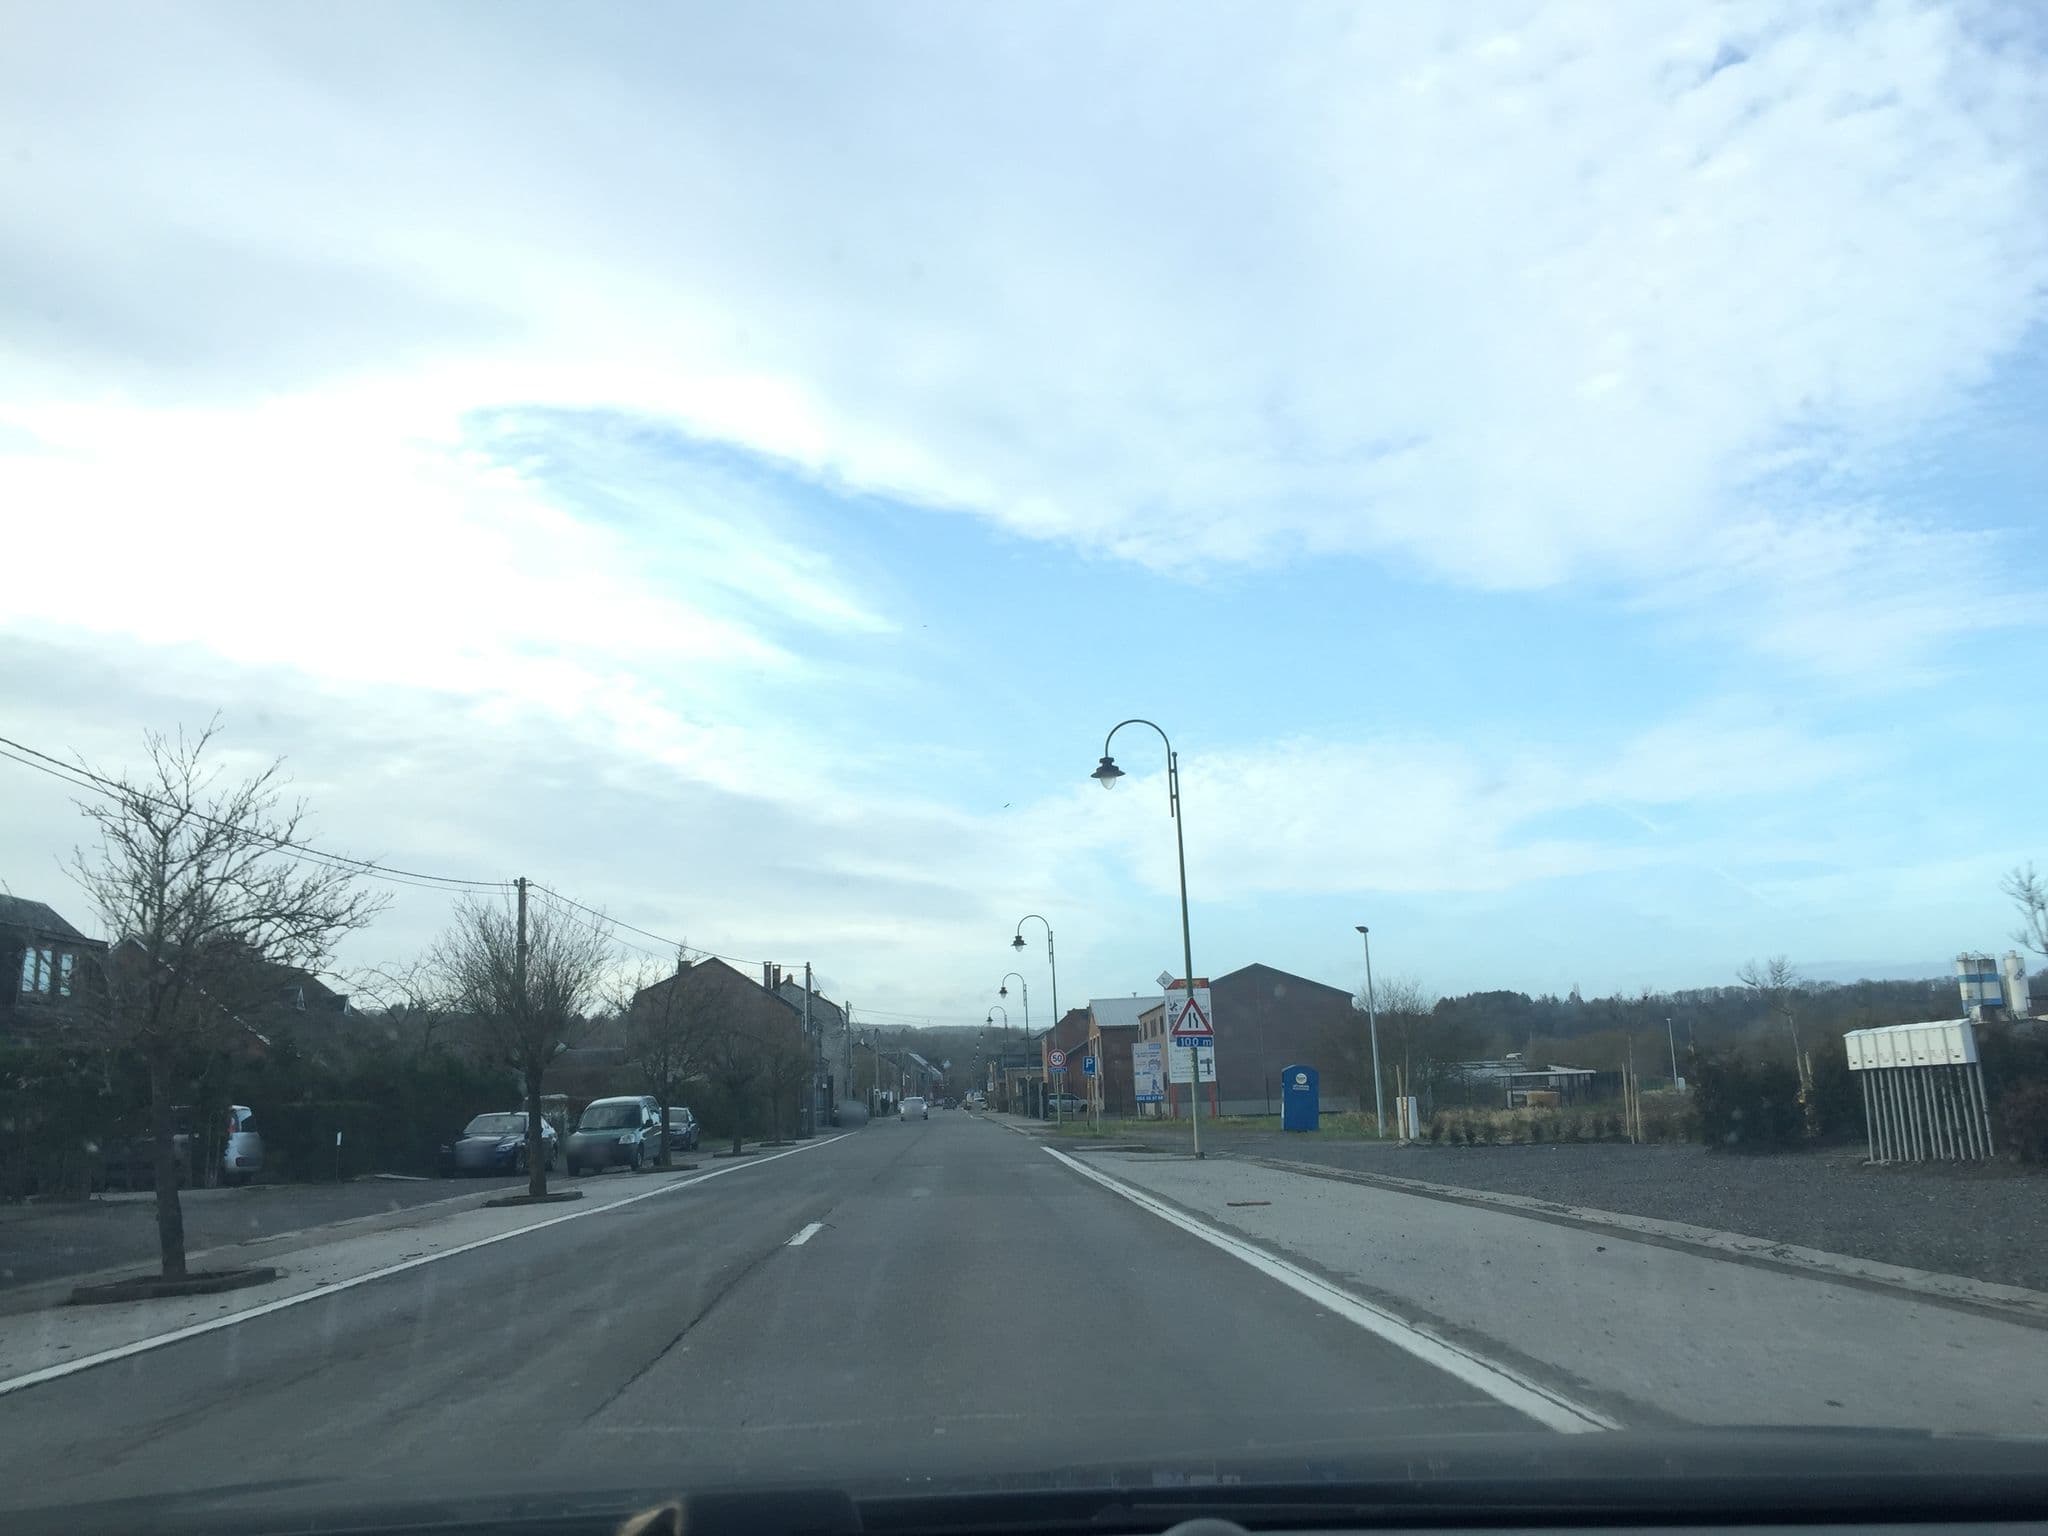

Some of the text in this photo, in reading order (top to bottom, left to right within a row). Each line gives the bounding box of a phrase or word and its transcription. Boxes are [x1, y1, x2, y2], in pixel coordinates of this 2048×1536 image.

[1181, 1037, 1199, 1046] 100
[1052, 1054, 1063, 1062] 50
[1086, 1058, 1093, 1068] P
